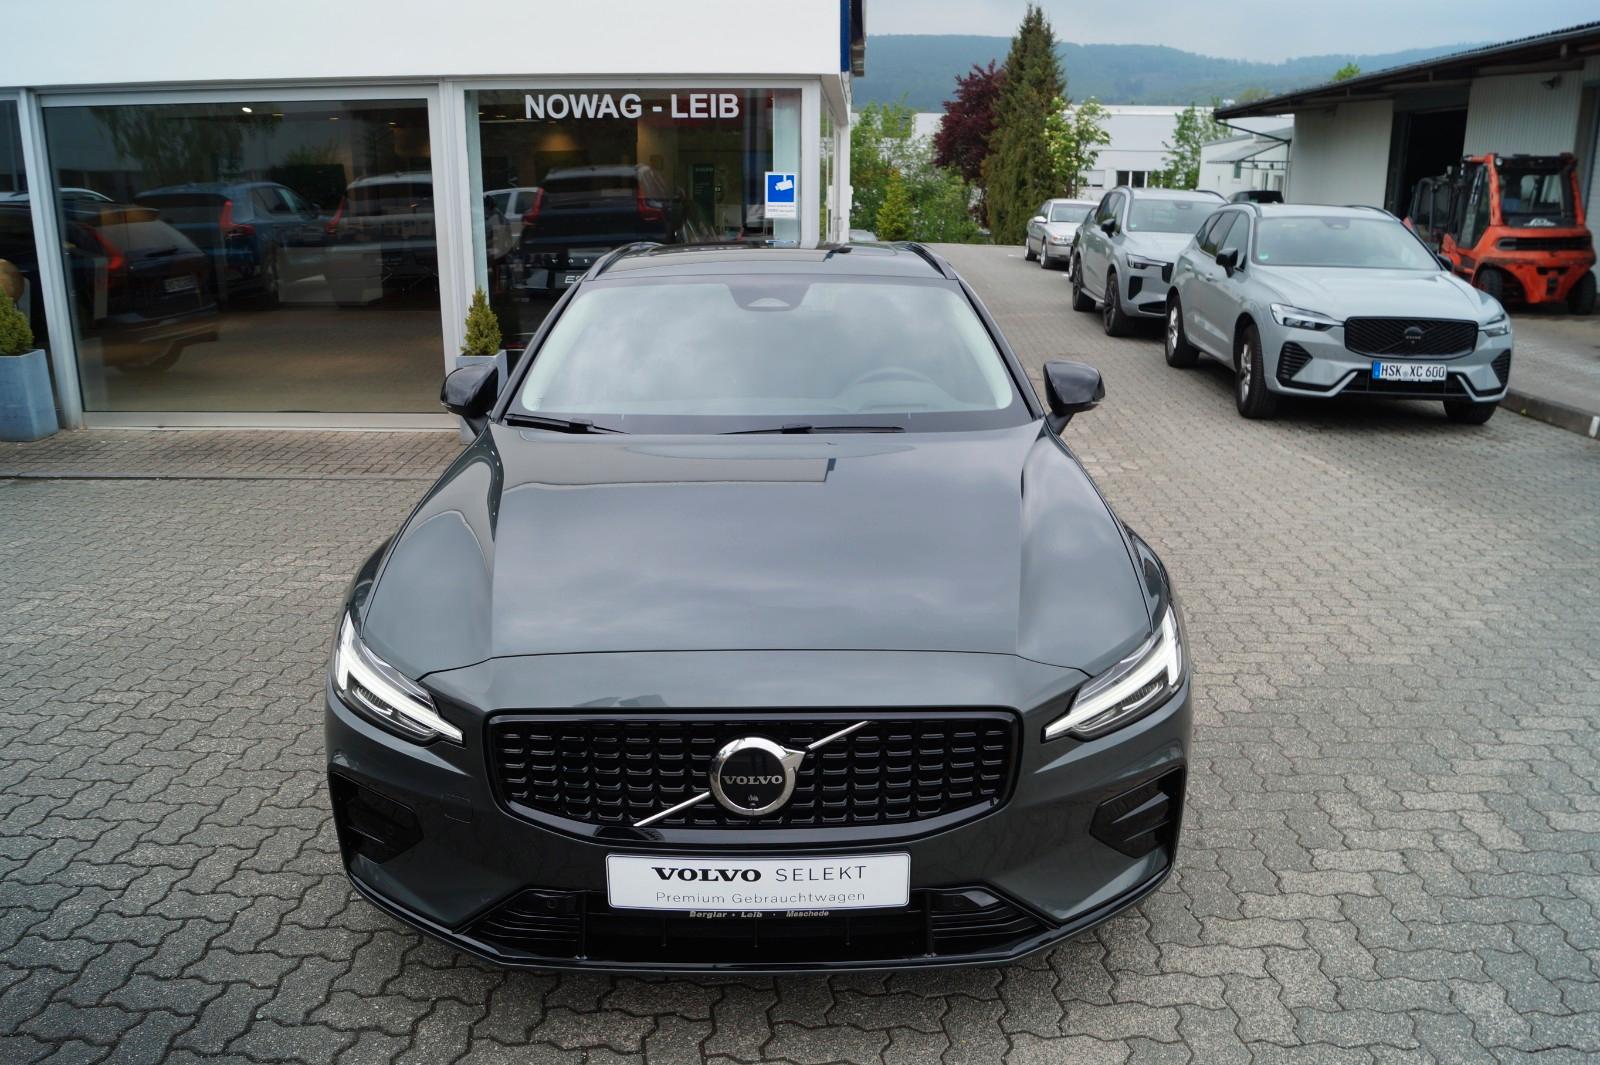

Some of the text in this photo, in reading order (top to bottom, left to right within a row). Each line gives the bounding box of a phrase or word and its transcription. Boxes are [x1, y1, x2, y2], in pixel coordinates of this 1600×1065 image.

[525, 93, 642, 119] NOWAG
[671, 93, 740, 118] LEIB
[1381, 364, 1445, 378] HSK XC 600
[722, 775, 783, 785] VOLVO
[651, 865, 867, 882] VOLVO SELEKT
[656, 891, 866, 905] Premium Gebrauchtwagen
